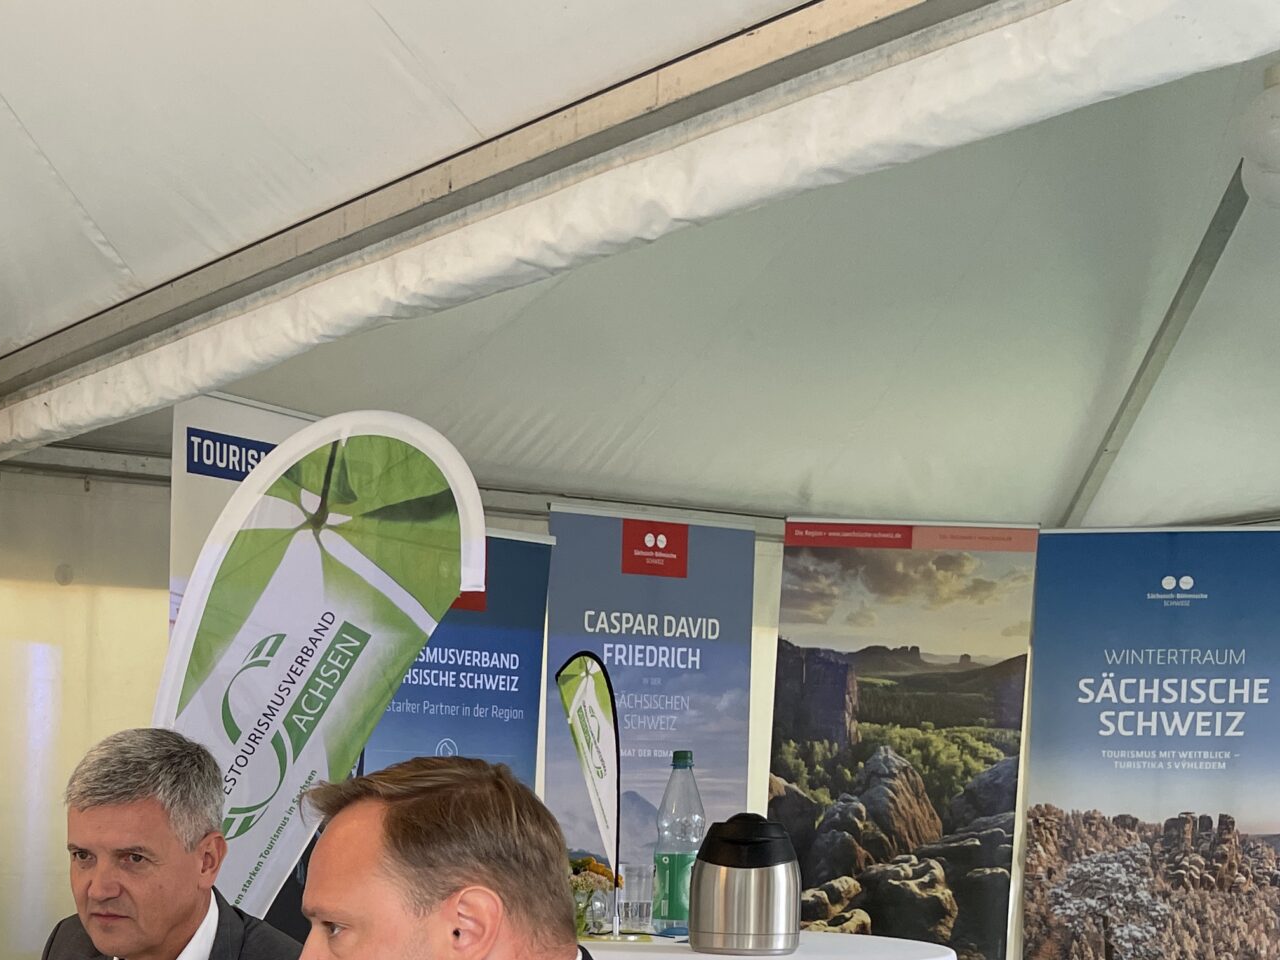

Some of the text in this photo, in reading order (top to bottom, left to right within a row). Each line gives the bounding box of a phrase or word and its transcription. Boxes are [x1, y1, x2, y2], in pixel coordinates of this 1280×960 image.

[190, 435, 266, 473] TOURIS
[584, 610, 720, 640] CASPAR DAVID
[413, 646, 520, 670] SMUSVERBAND
[603, 643, 701, 670] FRIEDRICH
[1104, 648, 1246, 666] WINTERTRAUM
[295, 633, 361, 735] ACHSEN
[459, 673, 520, 692] SCHWEIZ
[1077, 672, 1270, 705] SÄCHSISCHE
[423, 701, 460, 716] Partner
[462, 703, 471, 716] in
[473, 703, 489, 718] der
[491, 705, 524, 722] Region
[624, 714, 678, 731] SCHWEIZ
[1098, 711, 1246, 737] SCHWEIZ
[1101, 749, 1157, 759] TOURISMUS
[1159, 750, 1177, 759] MIT
[1178, 751, 1231, 759] WEITBLICK
[241, 860, 265, 895] starken
[258, 815, 291, 862] Tourismus
[286, 805, 297, 817] in
